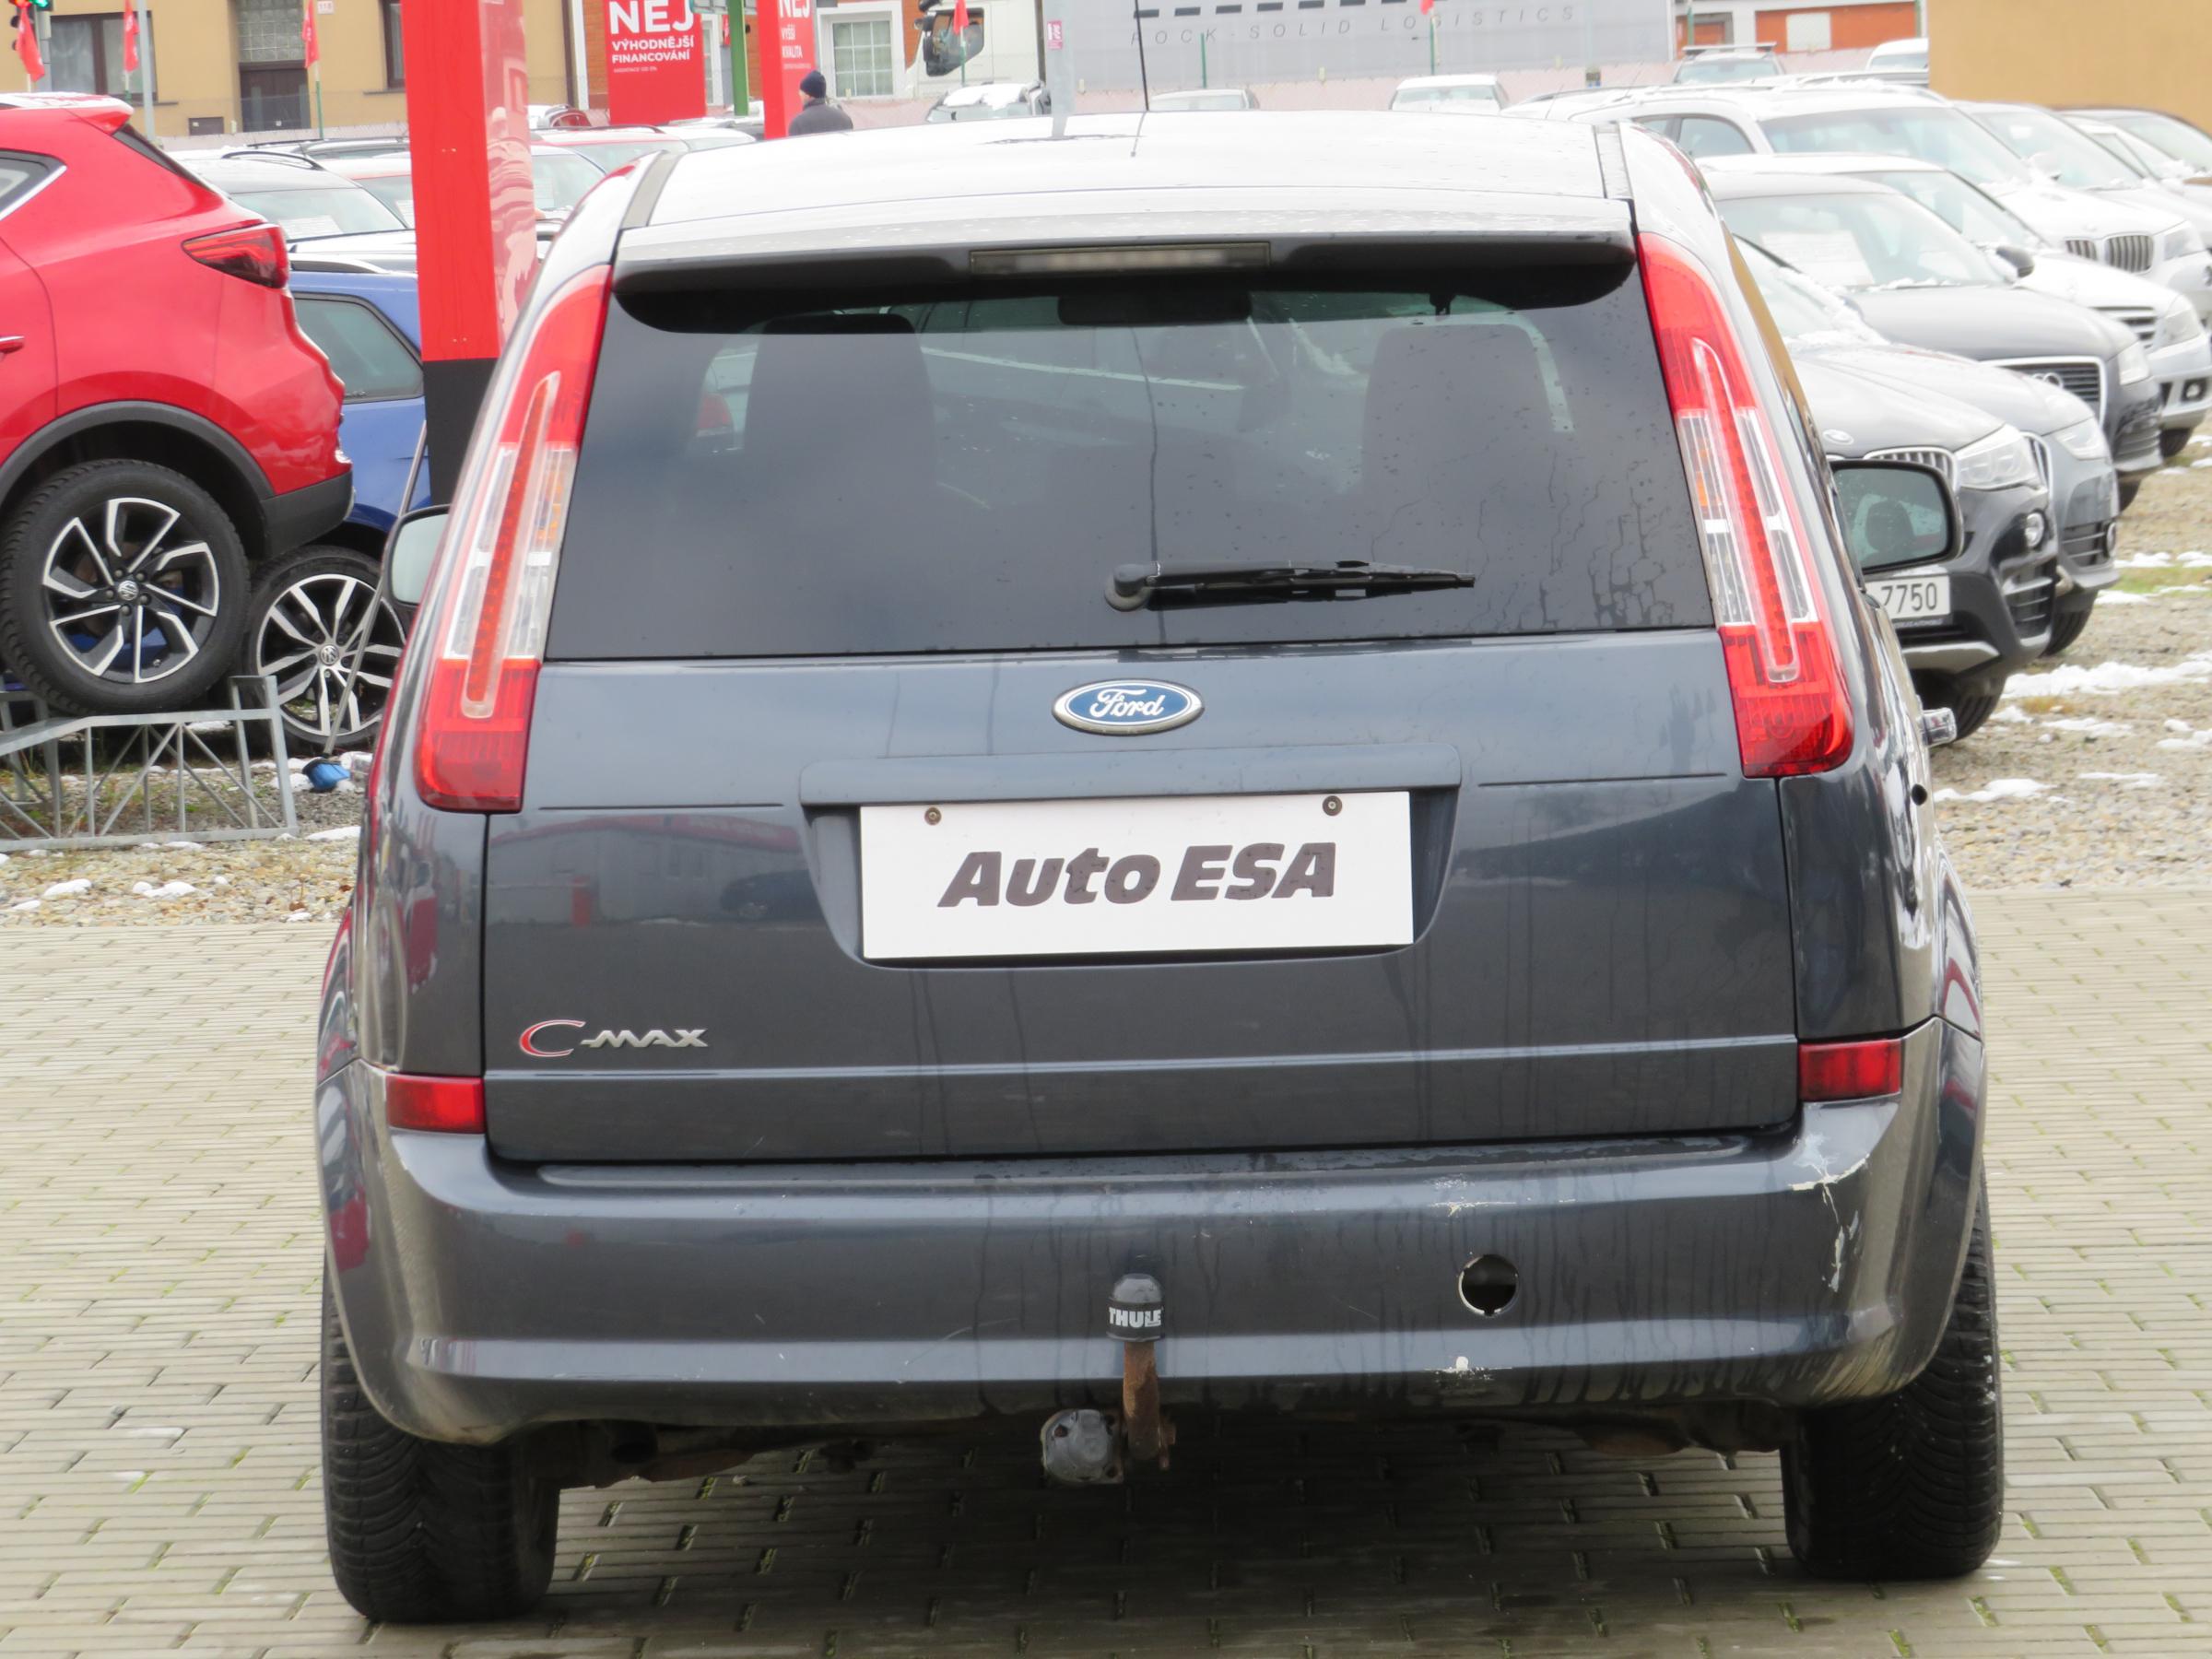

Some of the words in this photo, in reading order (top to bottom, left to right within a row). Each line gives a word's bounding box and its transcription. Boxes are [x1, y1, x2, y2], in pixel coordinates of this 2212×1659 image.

[608, 0, 695, 35] NEJ
[611, 34, 695, 52] VÝHODNĚJŠÍ
[611, 48, 691, 65] FINANCOVÁNÍ
[1880, 582, 1937, 614] 7750
[1088, 688, 1166, 718] Ford
[936, 846, 1161, 908] Auto
[1170, 841, 1337, 901] ESA
[1108, 1306, 1163, 1328] THULE
